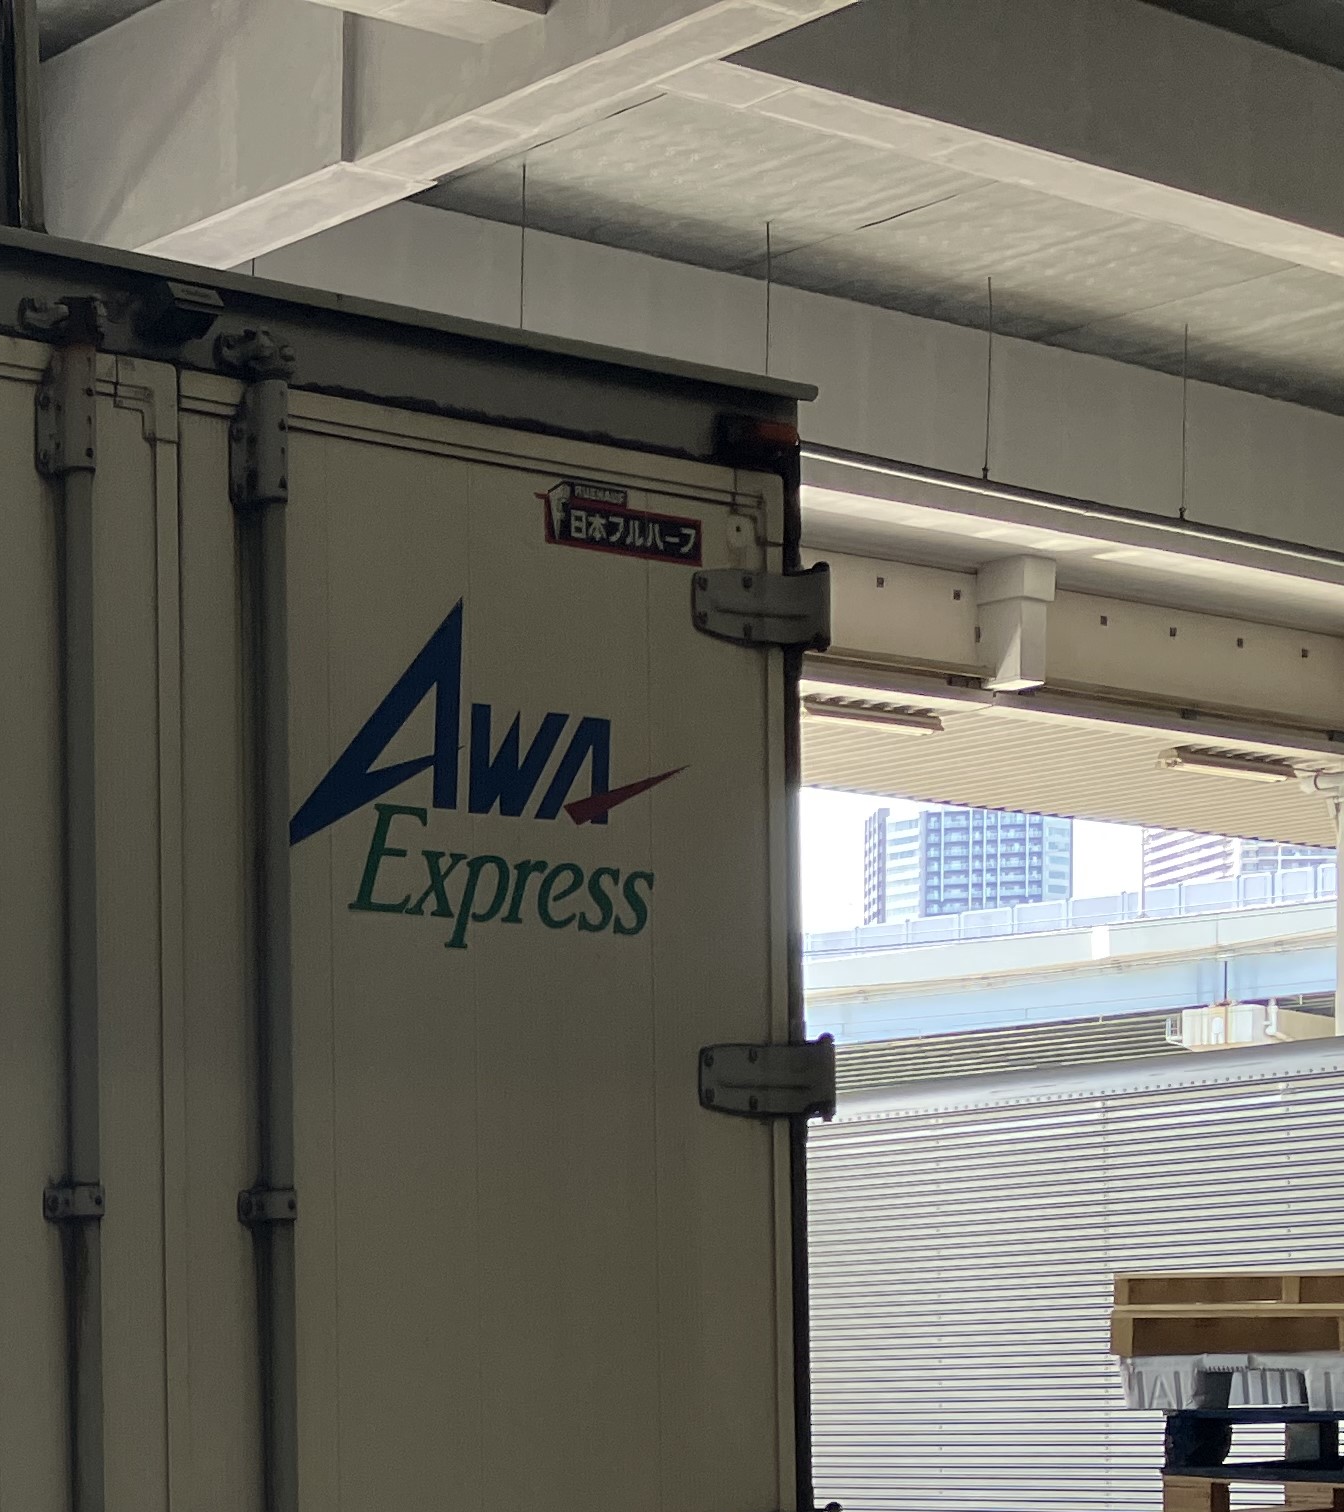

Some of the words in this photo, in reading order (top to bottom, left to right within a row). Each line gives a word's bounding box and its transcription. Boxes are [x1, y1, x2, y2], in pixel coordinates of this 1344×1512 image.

[570, 508, 697, 554] 日本フルハーフ
[348, 802, 655, 949] Express
